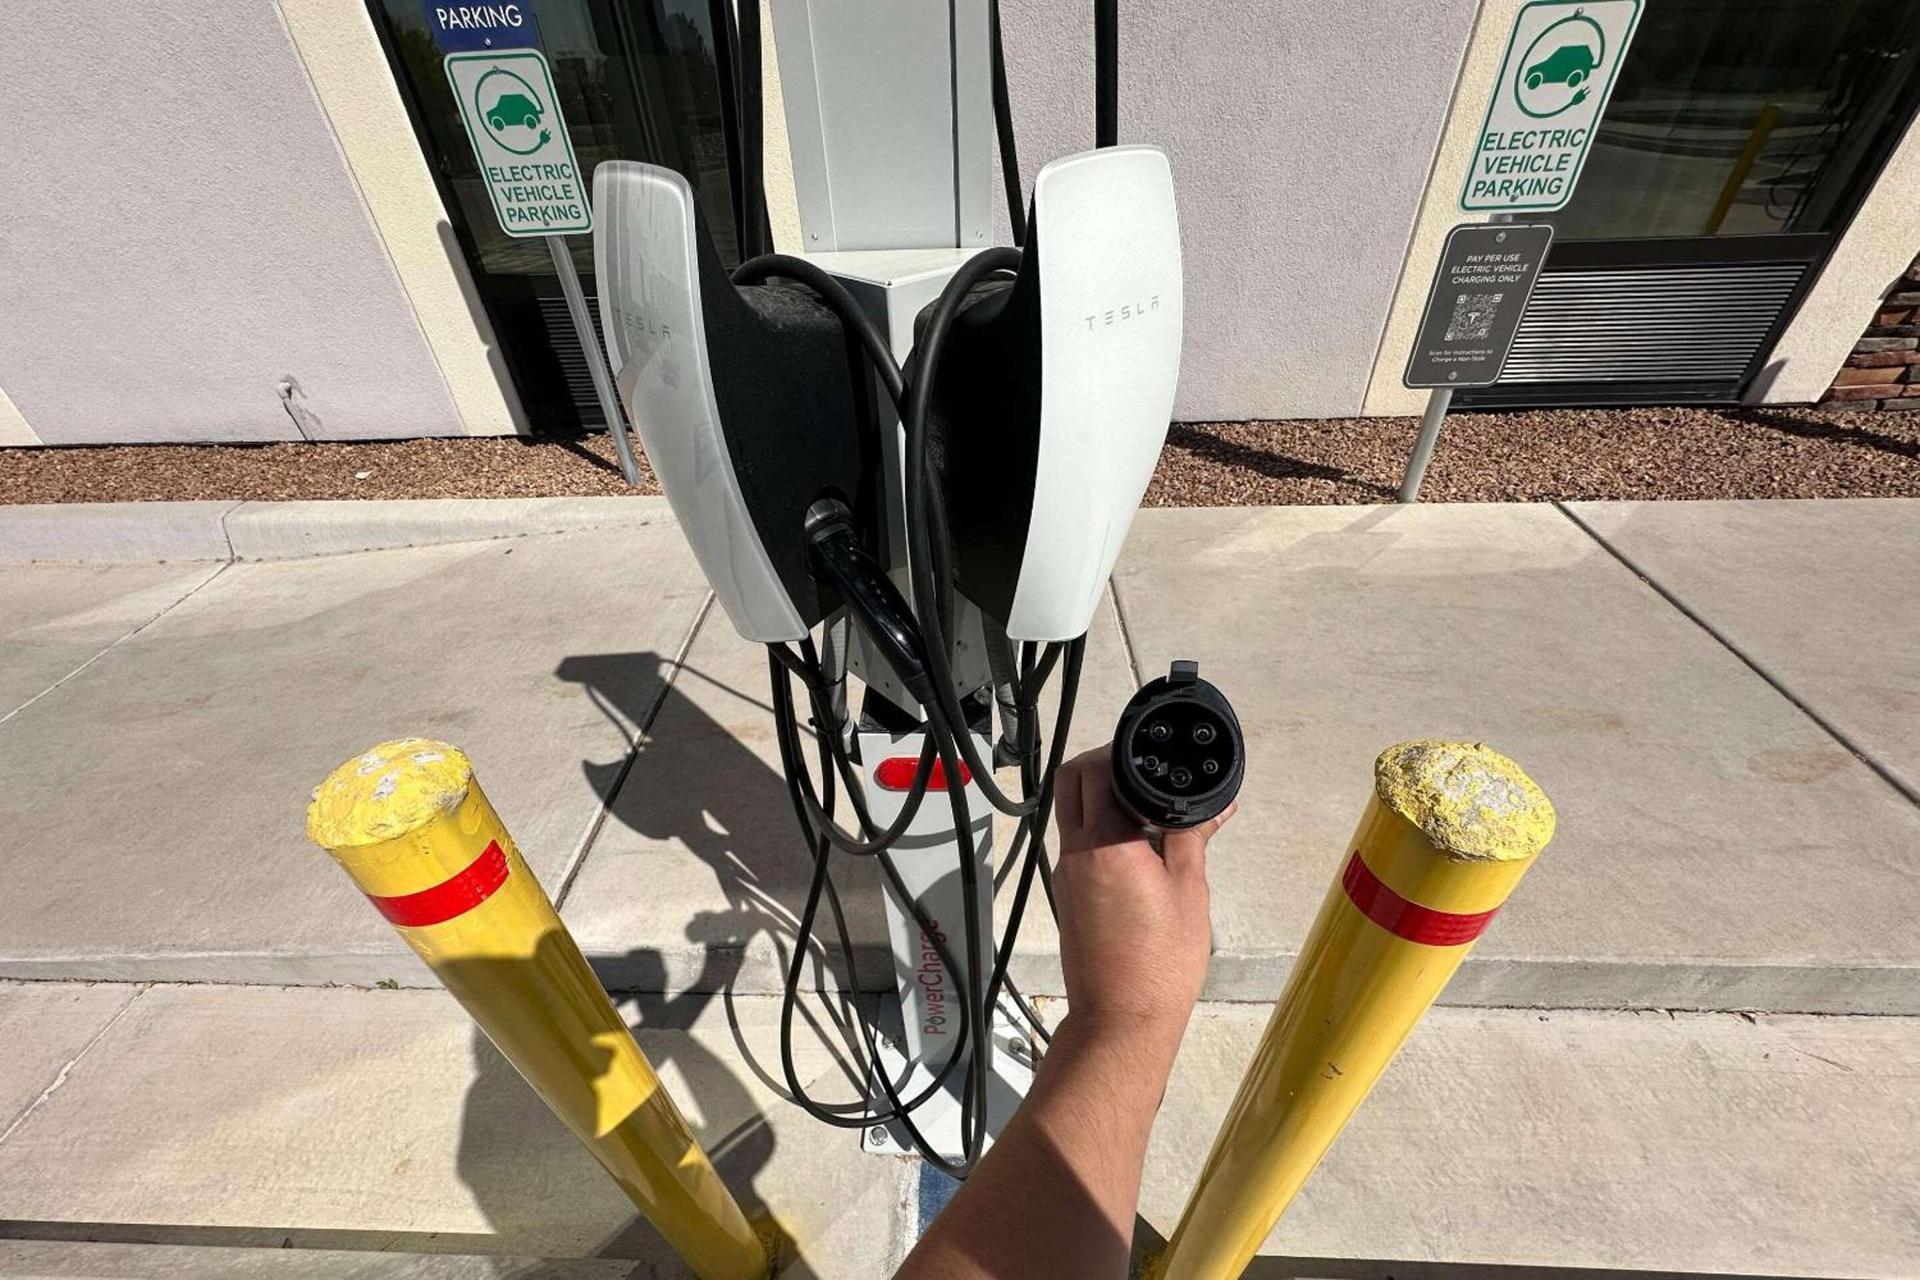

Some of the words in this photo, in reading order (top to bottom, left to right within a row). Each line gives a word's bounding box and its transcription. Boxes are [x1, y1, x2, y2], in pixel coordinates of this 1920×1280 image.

[436, 4, 523, 30] PARKING
[1483, 128, 1586, 151] ELECTRIC
[489, 163, 574, 183] ELECTRIC
[1484, 153, 1572, 174] VEHICLE
[501, 184, 575, 203] VEHICLE
[1472, 177, 1564, 198] PARKING
[506, 204, 582, 223] PARKING
[1466, 255, 1484, 263] PAY
[1484, 254, 1502, 262] PER
[1503, 253, 1521, 262] USE
[1451, 265, 1492, 274] ELECTRIC
[1494, 263, 1530, 272] VEHICLE
[1452, 275, 1496, 284] CHARGING
[1497, 274, 1522, 283] ONLY
[1085, 295, 1159, 330] TESLA
[615, 308, 672, 339] TESLA
